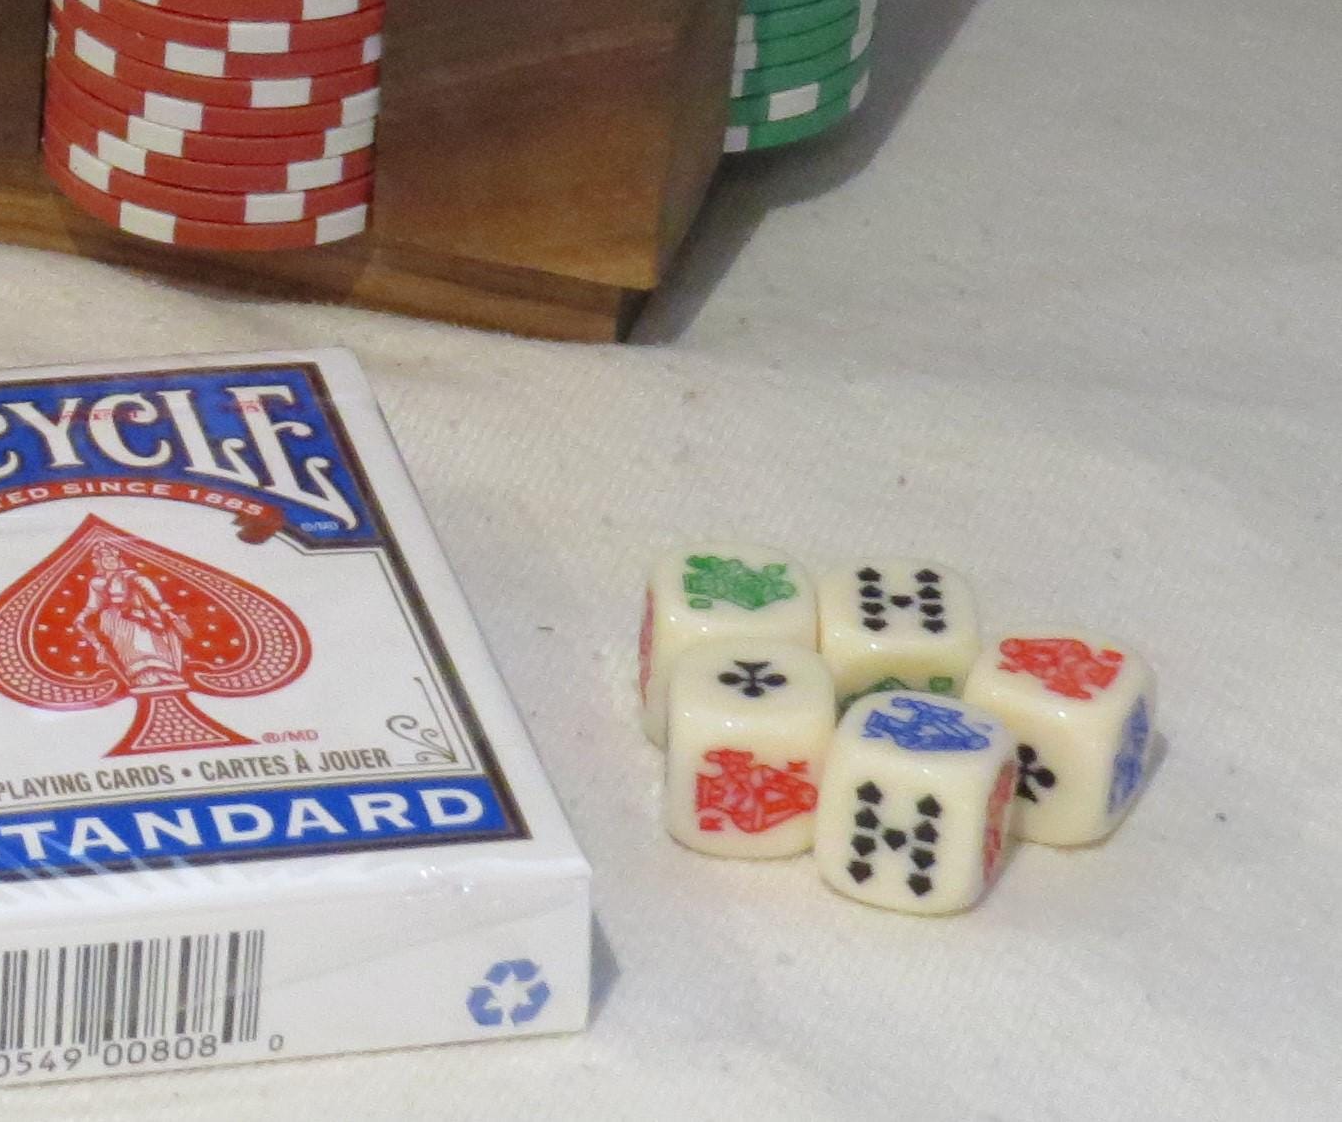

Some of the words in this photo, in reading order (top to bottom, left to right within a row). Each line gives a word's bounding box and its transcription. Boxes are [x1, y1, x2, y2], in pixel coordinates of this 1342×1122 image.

[63, 481, 172, 496] SINCE
[189, 489, 264, 516] 1885
[96, 764, 175, 790] CARDS
[199, 754, 290, 782] CARTES
[293, 749, 313, 773] À
[319, 747, 392, 772] JOUER
[102, 1034, 218, 1067] 00808
[269, 1034, 284, 1052] 0
